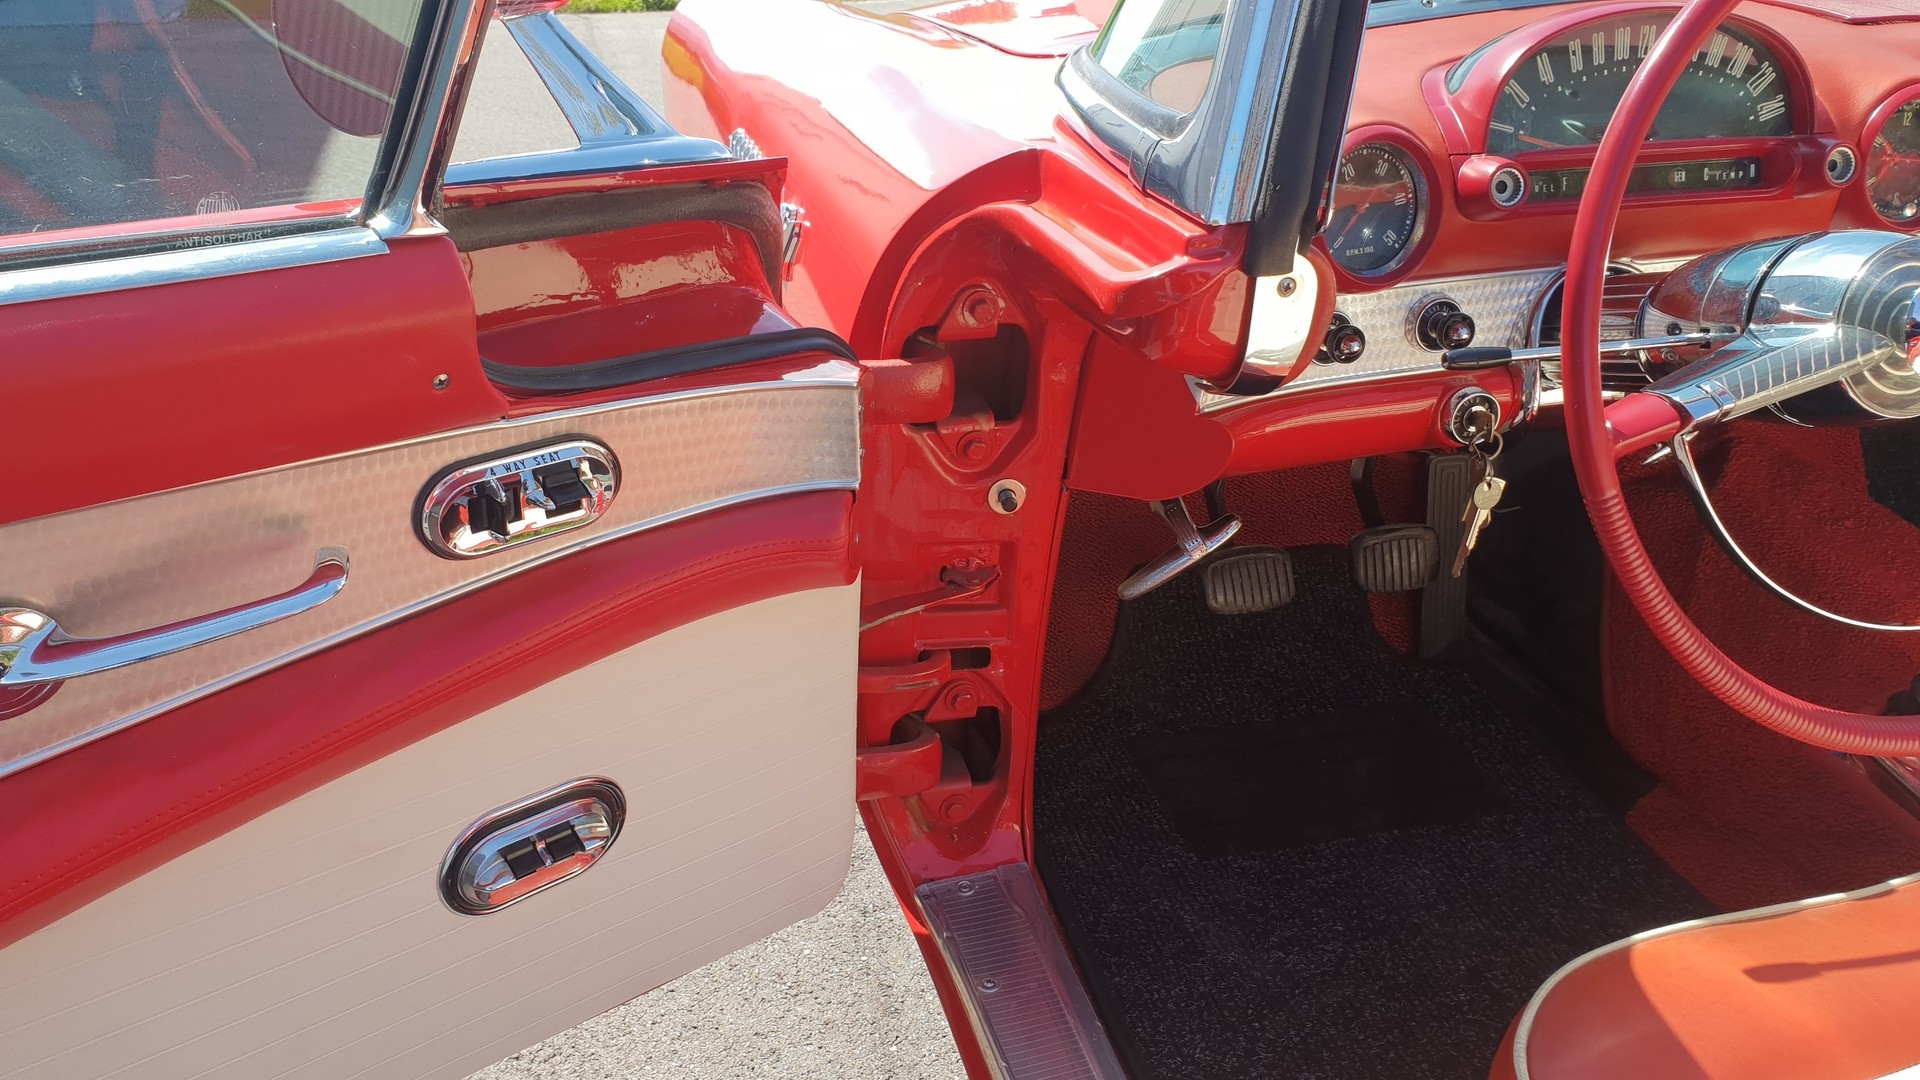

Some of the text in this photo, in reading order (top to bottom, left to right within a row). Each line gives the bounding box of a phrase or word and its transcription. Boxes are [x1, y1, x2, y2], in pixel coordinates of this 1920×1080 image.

[1568, 39, 1583, 73] 60
[1592, 32, 1605, 66] 80
[1614, 27, 1631, 61] 100
[1704, 33, 1728, 68] 180
[1536, 52, 1554, 85] 40
[1726, 42, 1753, 78] 200
[1746, 61, 1776, 96] 220
[1504, 79, 1530, 109] 20
[1757, 94, 1785, 122] 240
[1903, 111, 1912, 126] 12
[1342, 163, 1355, 181] 20
[1375, 159, 1388, 177] 30
[1716, 170, 1744, 180] TEMP
[1394, 192, 1406, 206] 40
[1534, 184, 1555, 193] UEL
[1382, 229, 1397, 246] 50
[490, 451, 561, 477] 4 WAY SEAT
